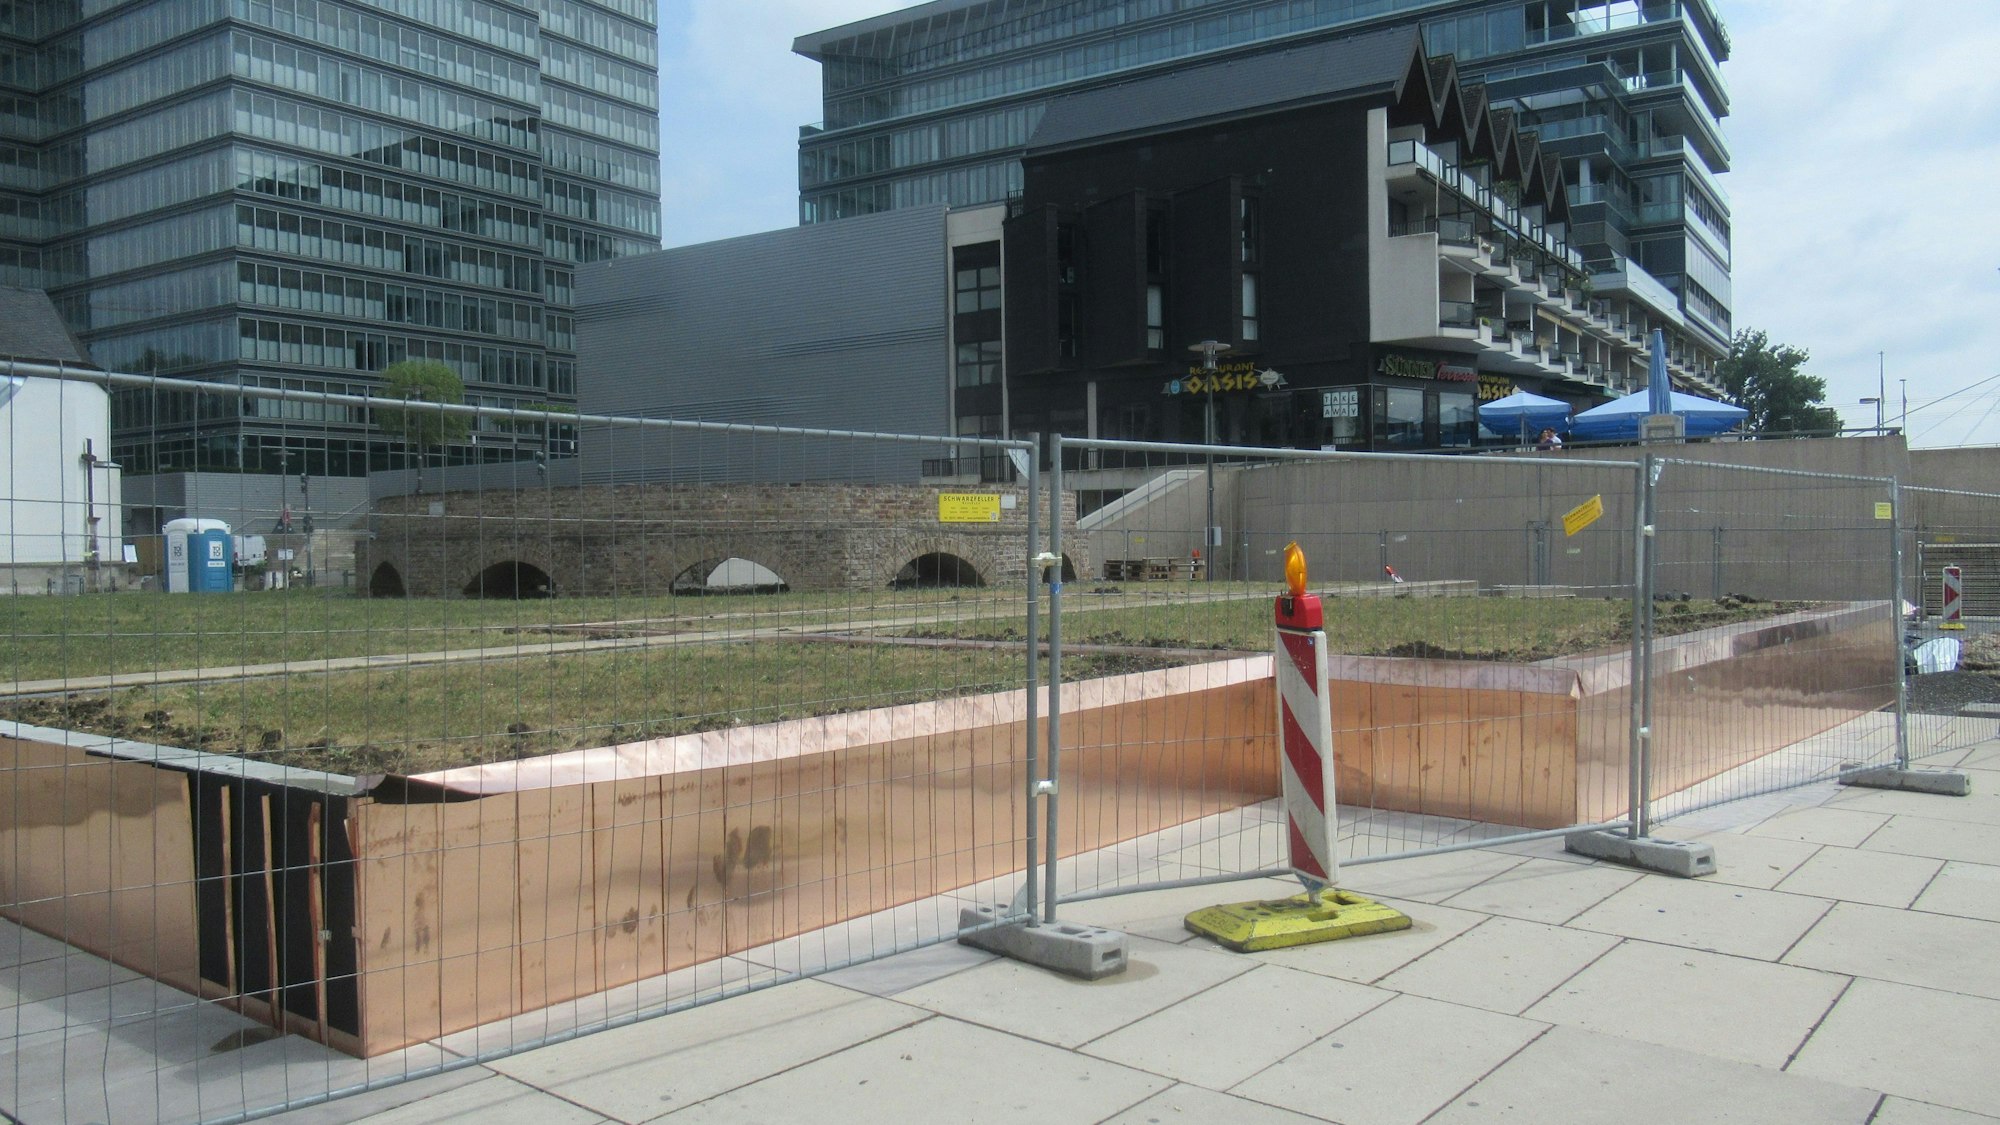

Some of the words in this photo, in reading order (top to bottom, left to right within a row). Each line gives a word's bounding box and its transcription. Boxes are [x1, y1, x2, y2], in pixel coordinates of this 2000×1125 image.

[1186, 372, 1258, 395] OASIS
[1324, 394, 1356, 403] TAKE
[1324, 408, 1356, 416] AWAY
